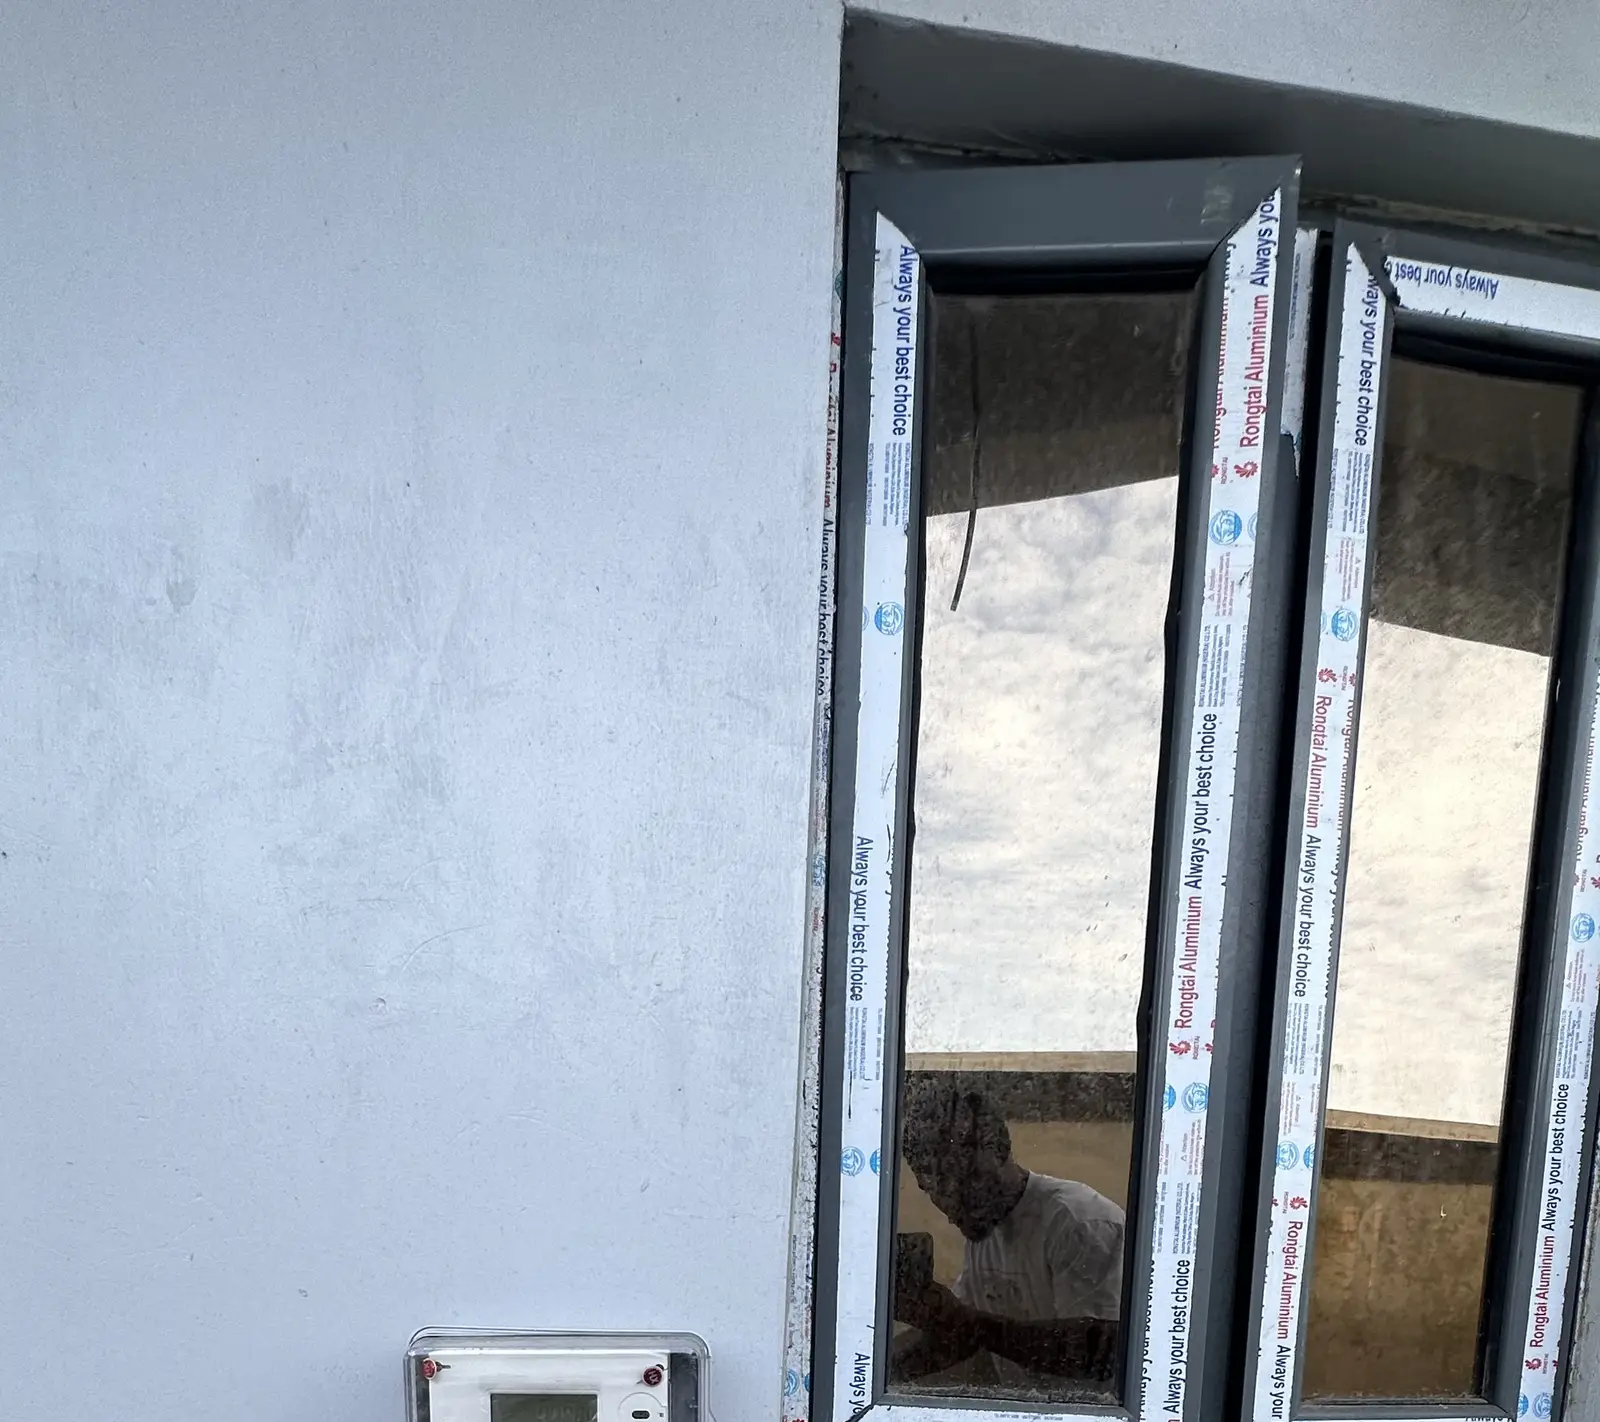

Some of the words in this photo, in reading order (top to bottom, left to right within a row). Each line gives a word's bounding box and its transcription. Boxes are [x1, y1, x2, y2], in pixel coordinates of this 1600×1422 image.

[895, 245, 918, 303] Always
[1250, 228, 1277, 287] Always
[1395, 262, 1422, 287] best
[1425, 266, 1453, 287] your
[1455, 270, 1499, 299] Always
[893, 303, 912, 343] your
[1245, 295, 1270, 382] Aluminium
[1360, 320, 1378, 358] your
[895, 347, 915, 381] best
[1360, 359, 1377, 393] best
[893, 384, 912, 436] choice
[1240, 386, 1267, 448] Rongtai
[1355, 397, 1374, 447] choice
[1220, 457, 1229, 484] RONGTAI
[1196, 713, 1217, 763] choice
[1311, 695, 1332, 750] Rongtai
[1193, 766, 1213, 797] best
[1306, 752, 1327, 828] Aluminium
[1192, 801, 1212, 834] your
[850, 836, 873, 886] Always
[1184, 837, 1209, 889] Always
[1300, 834, 1322, 884] Always
[850, 887, 867, 920] your
[1299, 885, 1316, 917] your
[851, 922, 871, 950] best
[1179, 896, 1203, 972] Aluminium
[1298, 918, 1317, 950] best
[849, 952, 869, 1001] choice
[1294, 952, 1315, 998] choice
[1174, 975, 1199, 1028] Rongtai
[1555, 1084, 1569, 1125] choice
[1551, 1127, 1566, 1156] best
[1548, 1157, 1562, 1187] your
[1541, 1187, 1561, 1231] Always
[1286, 1221, 1303, 1268] Rongtai
[1175, 1260, 1191, 1304] choice
[1536, 1235, 1555, 1300] Aluminium
[1173, 1307, 1187, 1338] best
[1277, 1268, 1297, 1340] Aluminium
[1530, 1301, 1550, 1348] Rongtai
[849, 1352, 871, 1399] Always
[1170, 1340, 1187, 1371] your
[1271, 1344, 1291, 1388] Always
[1163, 1372, 1183, 1414] Always
[1270, 1390, 1285, 1419] your
